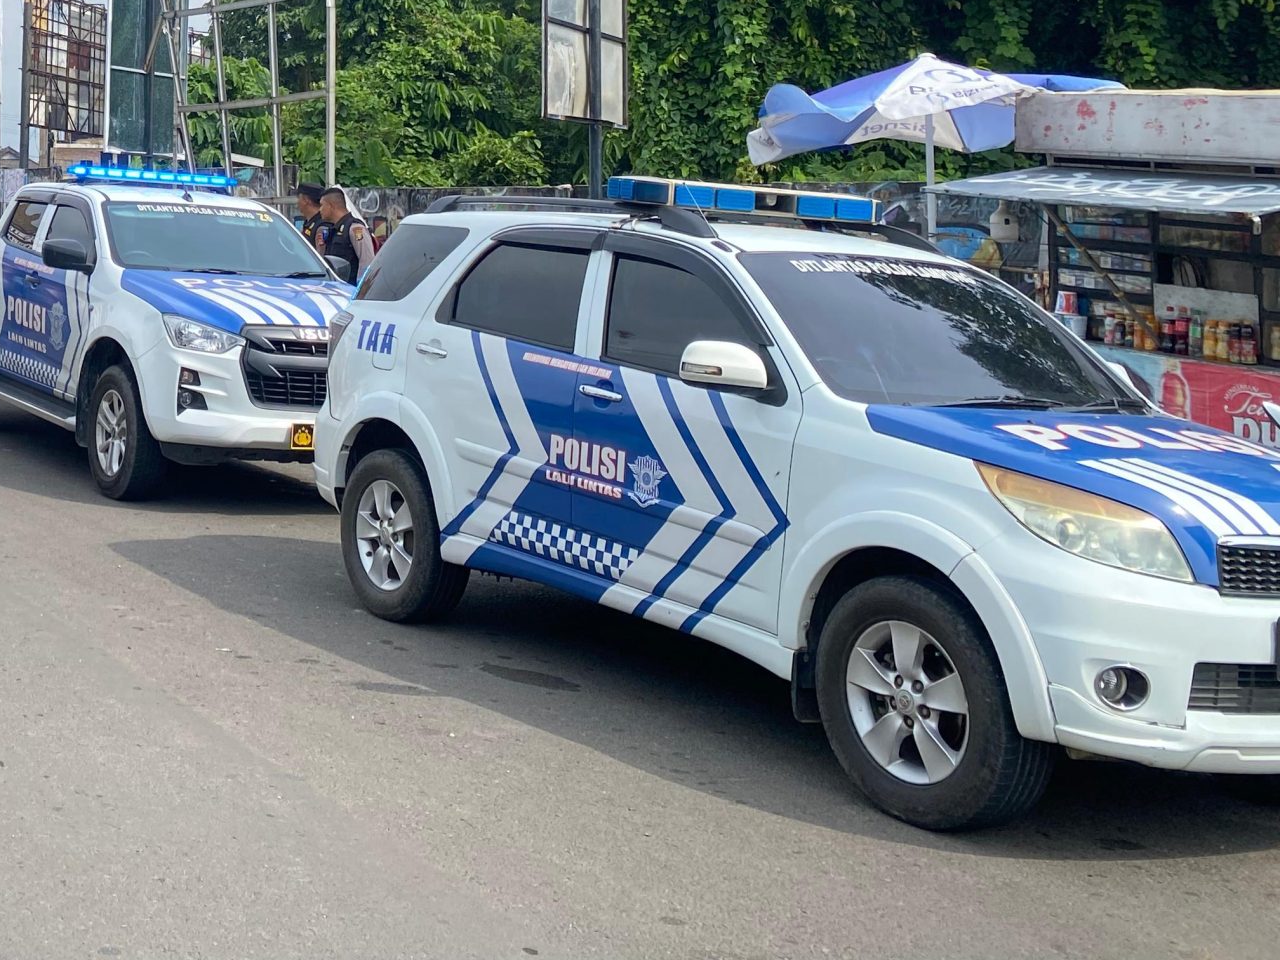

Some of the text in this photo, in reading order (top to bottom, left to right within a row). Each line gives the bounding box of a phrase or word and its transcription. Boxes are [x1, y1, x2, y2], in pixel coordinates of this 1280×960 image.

[789, 259, 872, 274] DITLANTAS
[171, 277, 353, 299] POLISI
[7, 294, 47, 335] POLISI
[7, 330, 48, 354] LALU LINTAS
[298, 328, 331, 340] ISU
[357, 319, 397, 355] TAA
[995, 423, 1280, 458] POLISI
[549, 433, 626, 483] POLISI
[545, 469, 623, 500] LALU LINTAS
